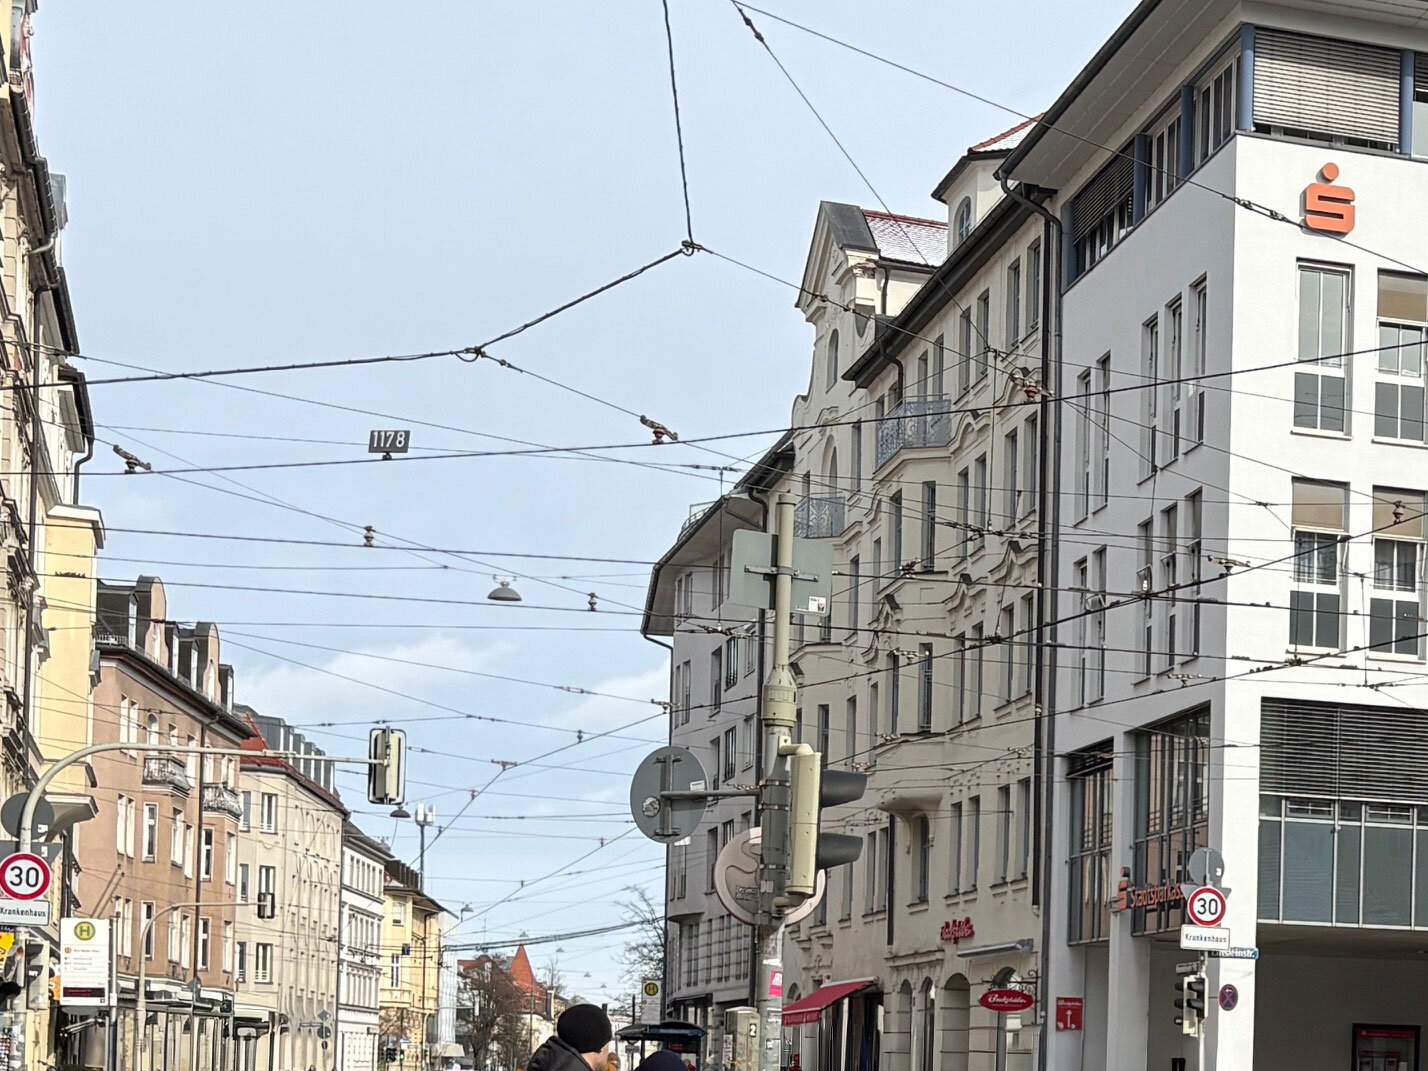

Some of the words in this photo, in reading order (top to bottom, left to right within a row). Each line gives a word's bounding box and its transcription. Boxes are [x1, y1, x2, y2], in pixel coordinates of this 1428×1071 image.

[373, 431, 405, 448] 1178
[9, 866, 39, 888] 30
[0, 906, 46, 918] Krankenhaus
[1196, 897, 1218, 915] 30
[79, 925, 90, 937] H
[1184, 933, 1227, 944] Krankenhaus
[749, 1024, 756, 1036] 2
